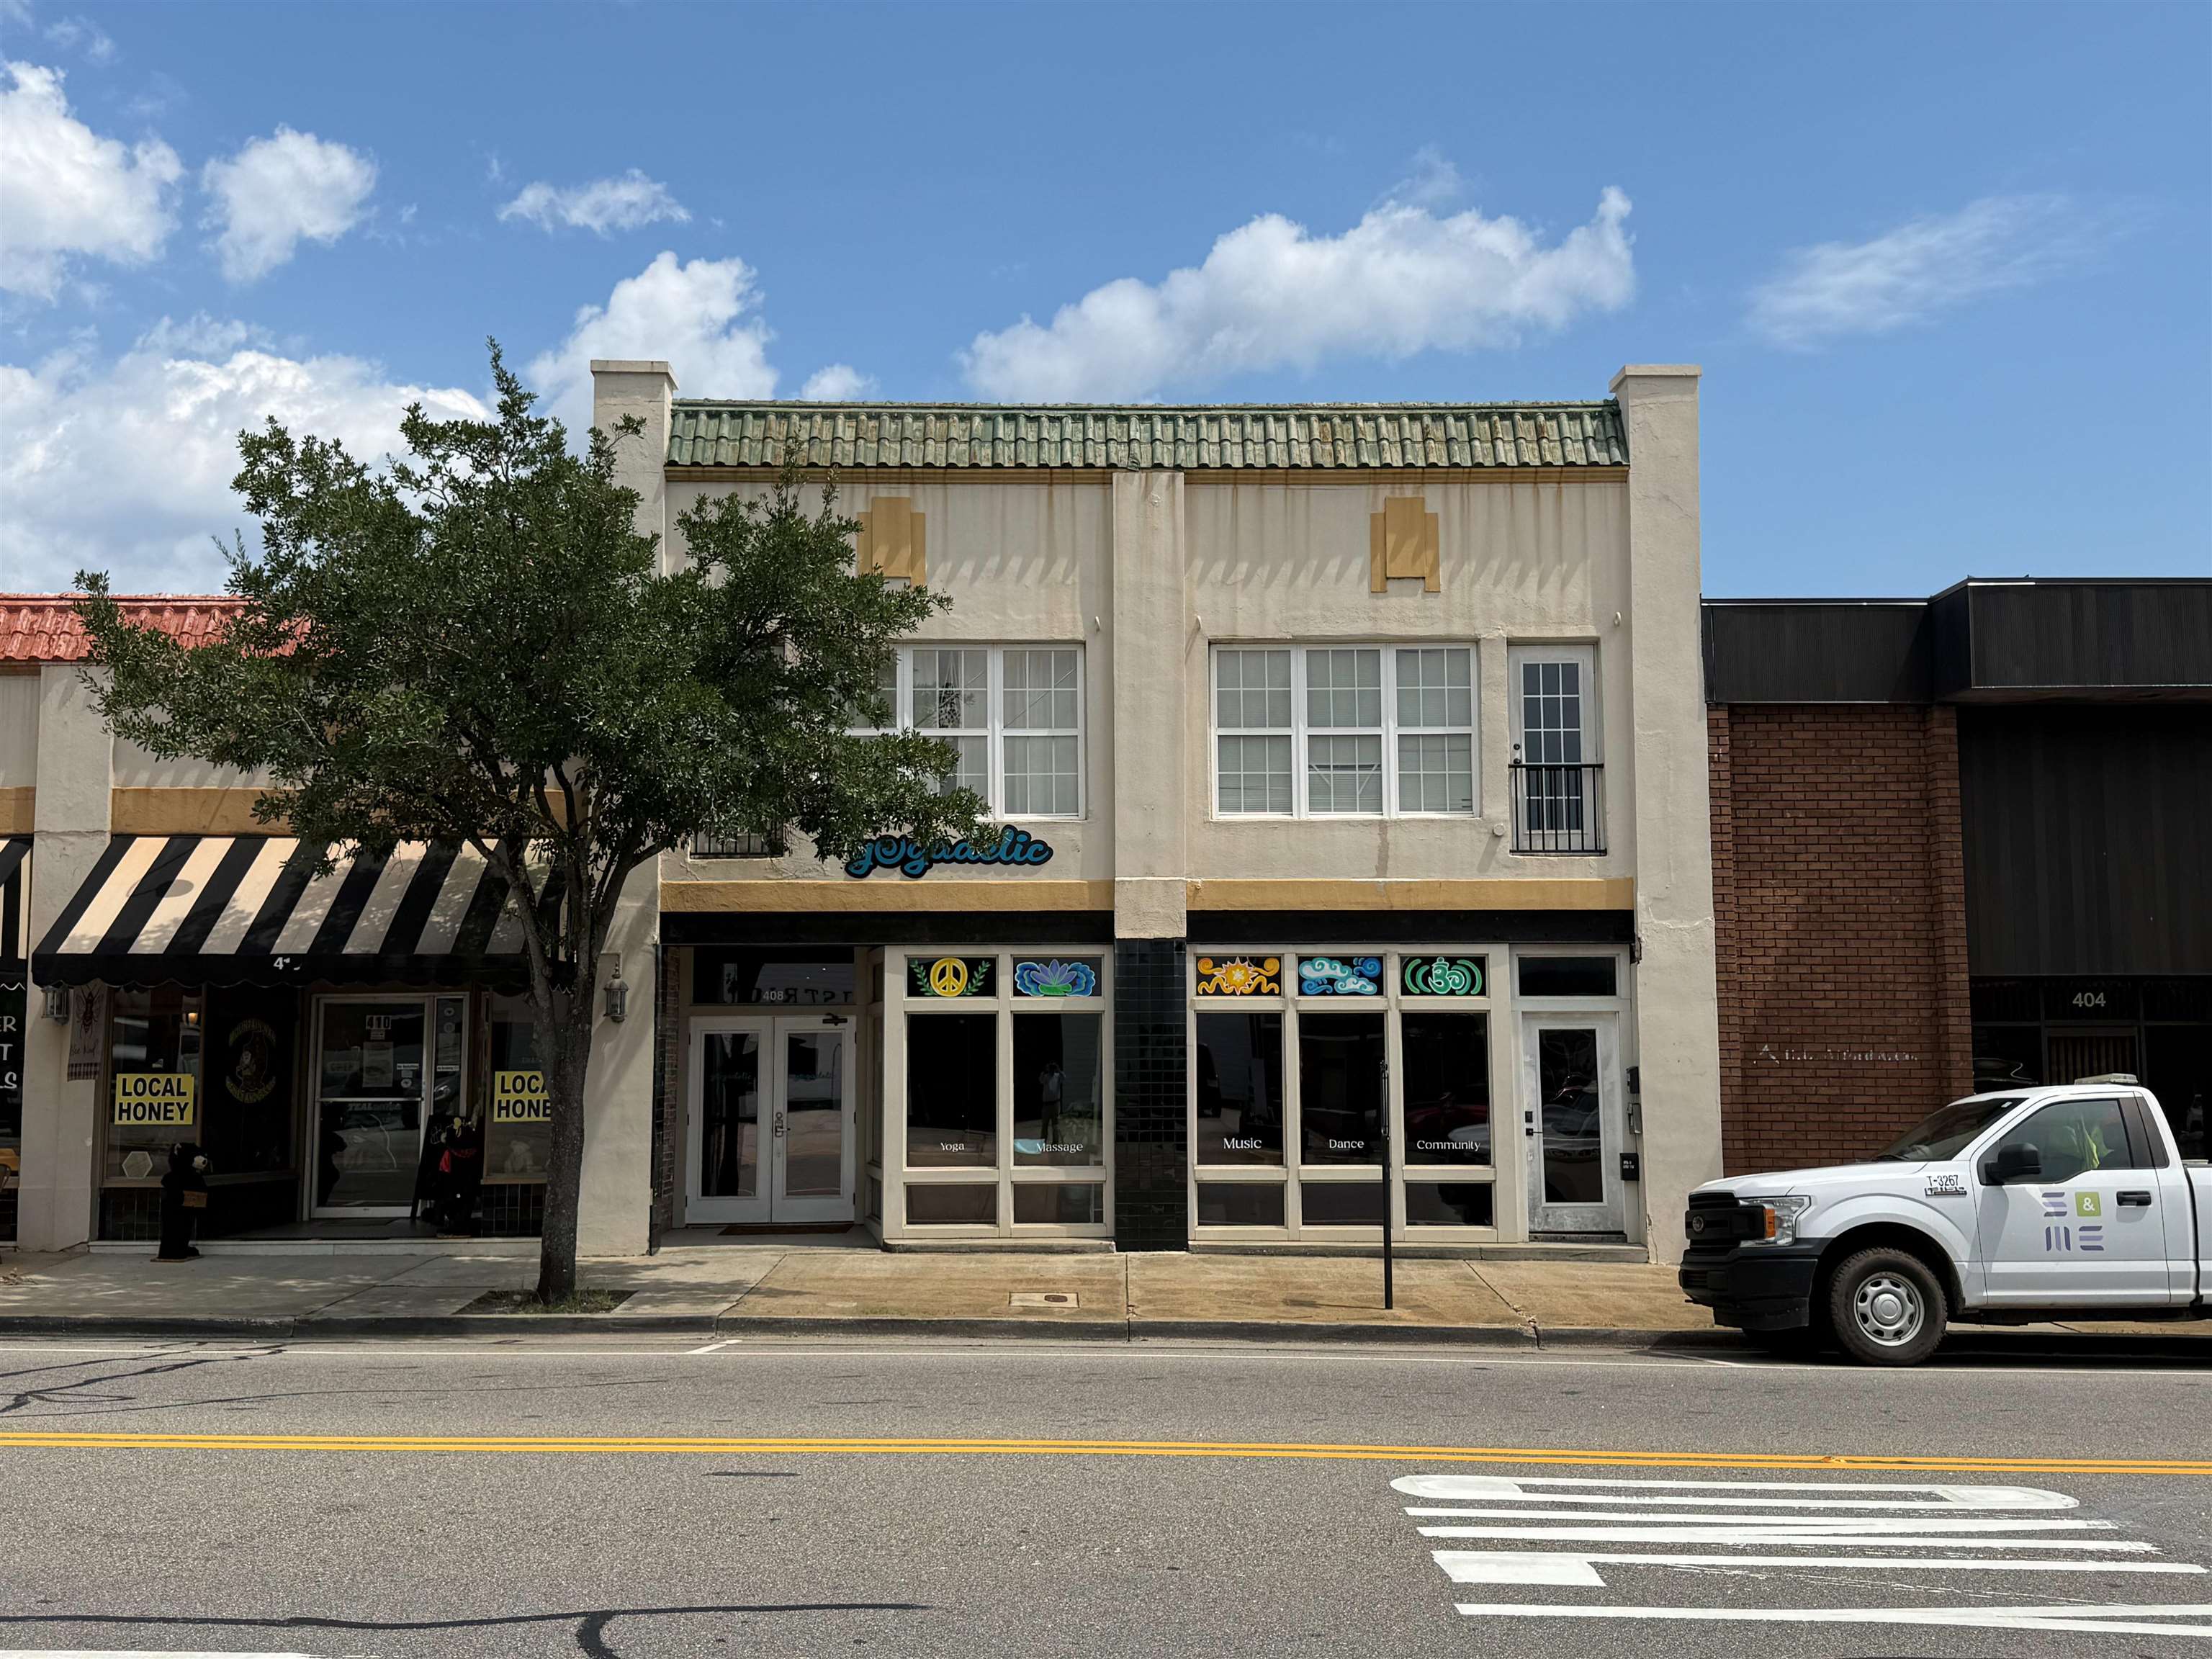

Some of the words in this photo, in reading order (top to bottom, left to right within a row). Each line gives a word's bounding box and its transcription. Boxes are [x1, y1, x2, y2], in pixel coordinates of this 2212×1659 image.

[763, 991, 784, 1001] 408
[2072, 992, 2106, 1007] 404
[367, 1015, 392, 1030] 410
[122, 1076, 188, 1097] LOCAL
[500, 1074, 549, 1094] LOC
[118, 1102, 189, 1121] HONEY
[496, 1099, 552, 1119] HONE
[940, 1141, 965, 1153] Yoga
[1035, 1141, 1084, 1154] Massage
[1223, 1137, 1262, 1151] Music
[1328, 1138, 1364, 1150] Dance
[1416, 1139, 1481, 1152] Community
[1926, 1174, 1959, 1187] T-3267
